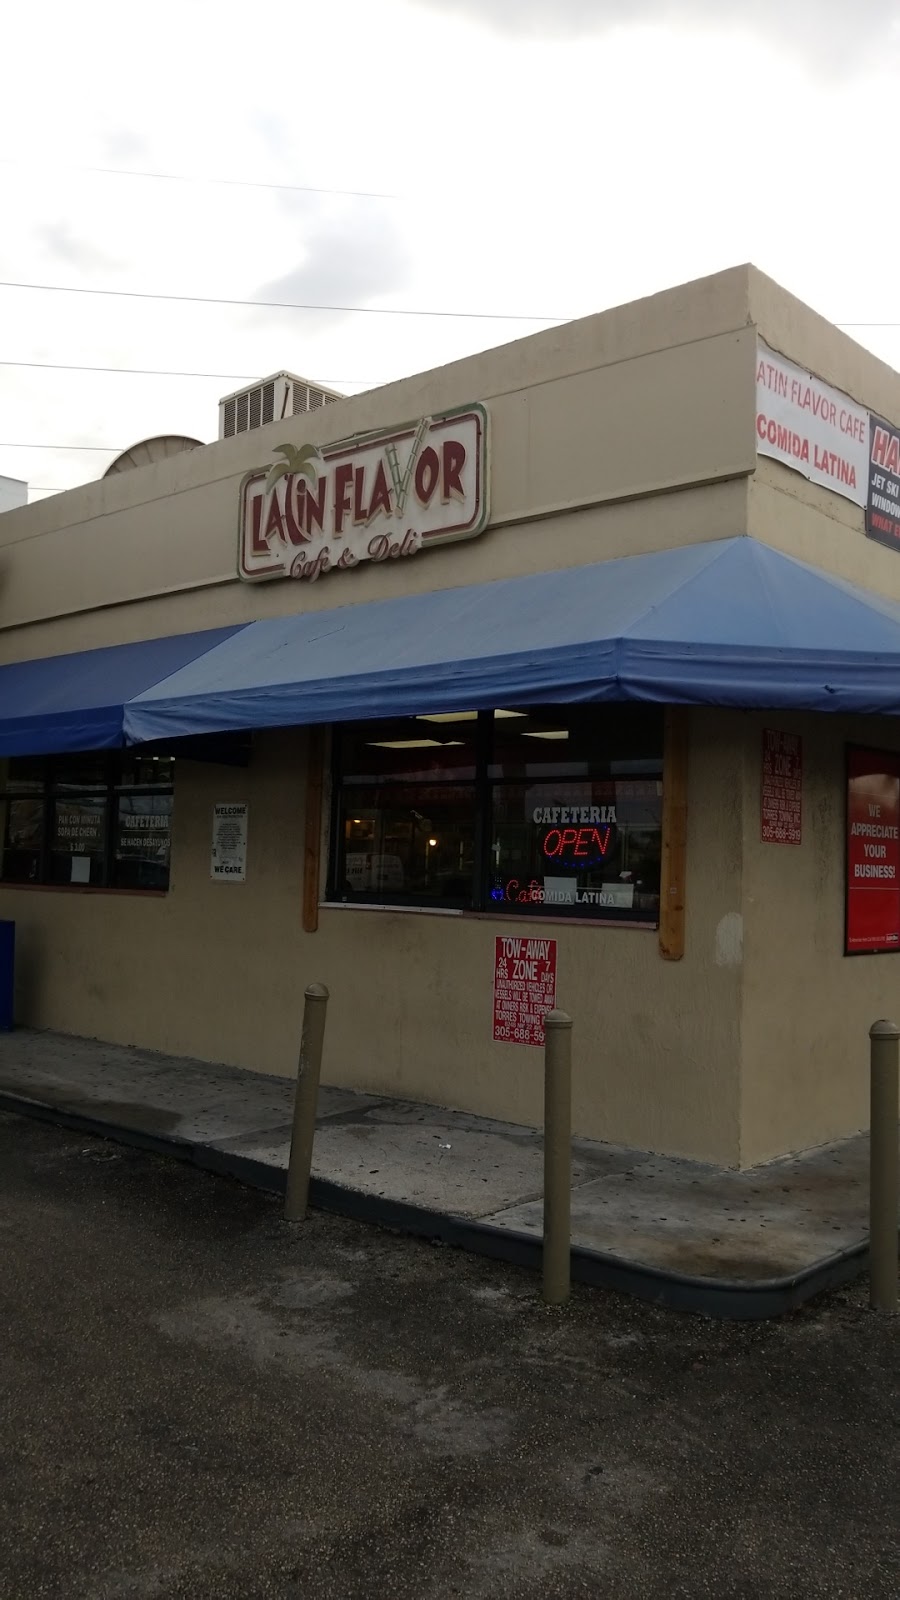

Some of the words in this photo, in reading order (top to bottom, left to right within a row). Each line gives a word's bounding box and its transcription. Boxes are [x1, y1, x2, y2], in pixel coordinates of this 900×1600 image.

[756, 360, 788, 398] ATIN
[791, 381, 837, 426] FLAVOR
[839, 410, 866, 443] CAFE
[756, 413, 809, 463] COMIDA
[813, 445, 857, 489] LATINA
[871, 425, 900, 478] HA
[333, 417, 467, 539] FLAVOR
[871, 473, 886, 490] JET
[886, 480, 899, 498] SKI
[872, 513, 892, 533] WHAT
[337, 548, 358, 568] &
[368, 528, 419, 561] Deli
[215, 807, 247, 815] WELCOME
[533, 805, 617, 824] CAFETERIA
[868, 804, 881, 818] WE
[69, 815, 80, 824] CON
[125, 815, 169, 828] CAFETERIA
[58, 827, 70, 837] SOPA
[71, 827, 78, 837] DE
[851, 823, 899, 839] APPRECIATE
[543, 827, 611, 856] OPEN
[864, 844, 886, 858] YOUR
[214, 865, 224, 873] WE
[854, 864, 896, 879] BUSINESS!
[531, 889, 572, 903] COMIDA
[575, 890, 616, 905] LATINA
[501, 938, 550, 960] TOW-AWAY
[496, 968, 508, 979] HRS
[541, 972, 555, 984] DAYS
[498, 957, 508, 968] 24
[512, 960, 539, 981] ZONE
[545, 961, 551, 972] 7
[526, 982, 546, 993] VEHICLES
[546, 984, 554, 994] OR
[495, 989, 512, 1000] VESSELS
[512, 990, 522, 1001] WILL
[522, 991, 529, 1002] BE
[529, 992, 544, 1004] TOWED
[495, 1000, 501, 1010] AT
[519, 1003, 530, 1013] RISK
[495, 1010, 517, 1023] TORRES
[518, 1013, 540, 1025] TOWING
[495, 1026, 546, 1042] 305-688-59
